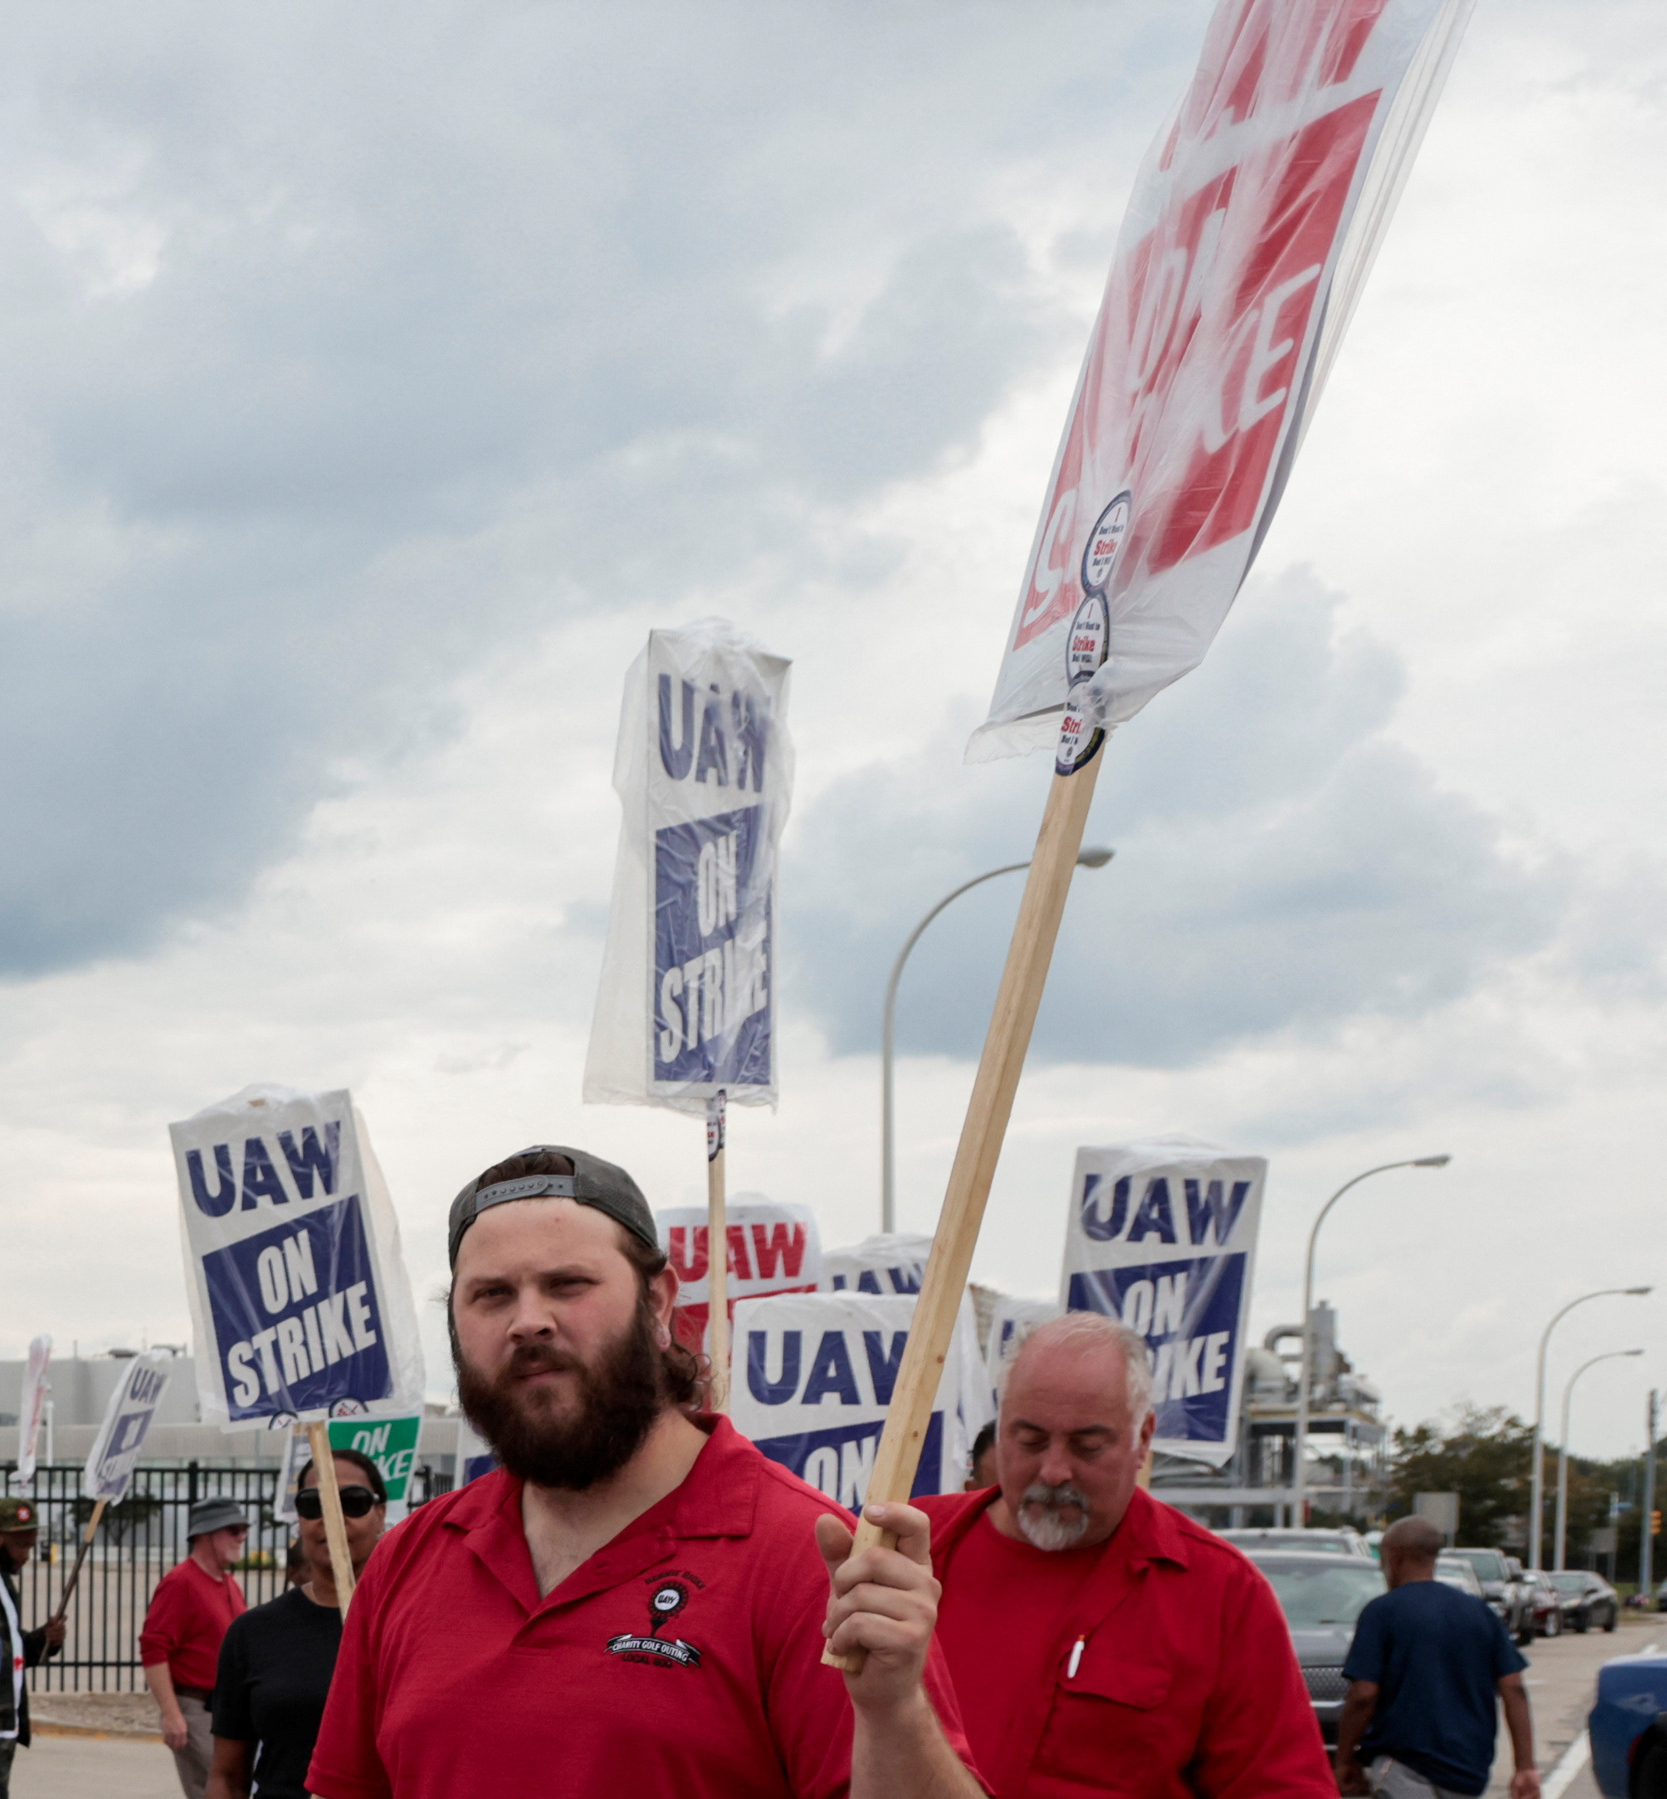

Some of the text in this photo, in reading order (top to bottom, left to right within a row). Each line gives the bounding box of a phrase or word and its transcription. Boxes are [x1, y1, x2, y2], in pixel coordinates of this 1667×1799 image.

[658, 673, 771, 793] UAW
[697, 829, 737, 938] ON
[185, 1120, 341, 1219] UAW
[1081, 1174, 1252, 1247] UAW
[257, 1229, 317, 1313] ON
[669, 1222, 809, 1283] UAW
[1122, 1271, 1189, 1338] ON
[227, 1280, 377, 1409] STRIKE
[1151, 1331, 1229, 1405] IKE
[351, 1423, 392, 1457] ON
[804, 1434, 877, 1516] ON
[612, 1640, 689, 1661] CHARITY GOLF OUTING
